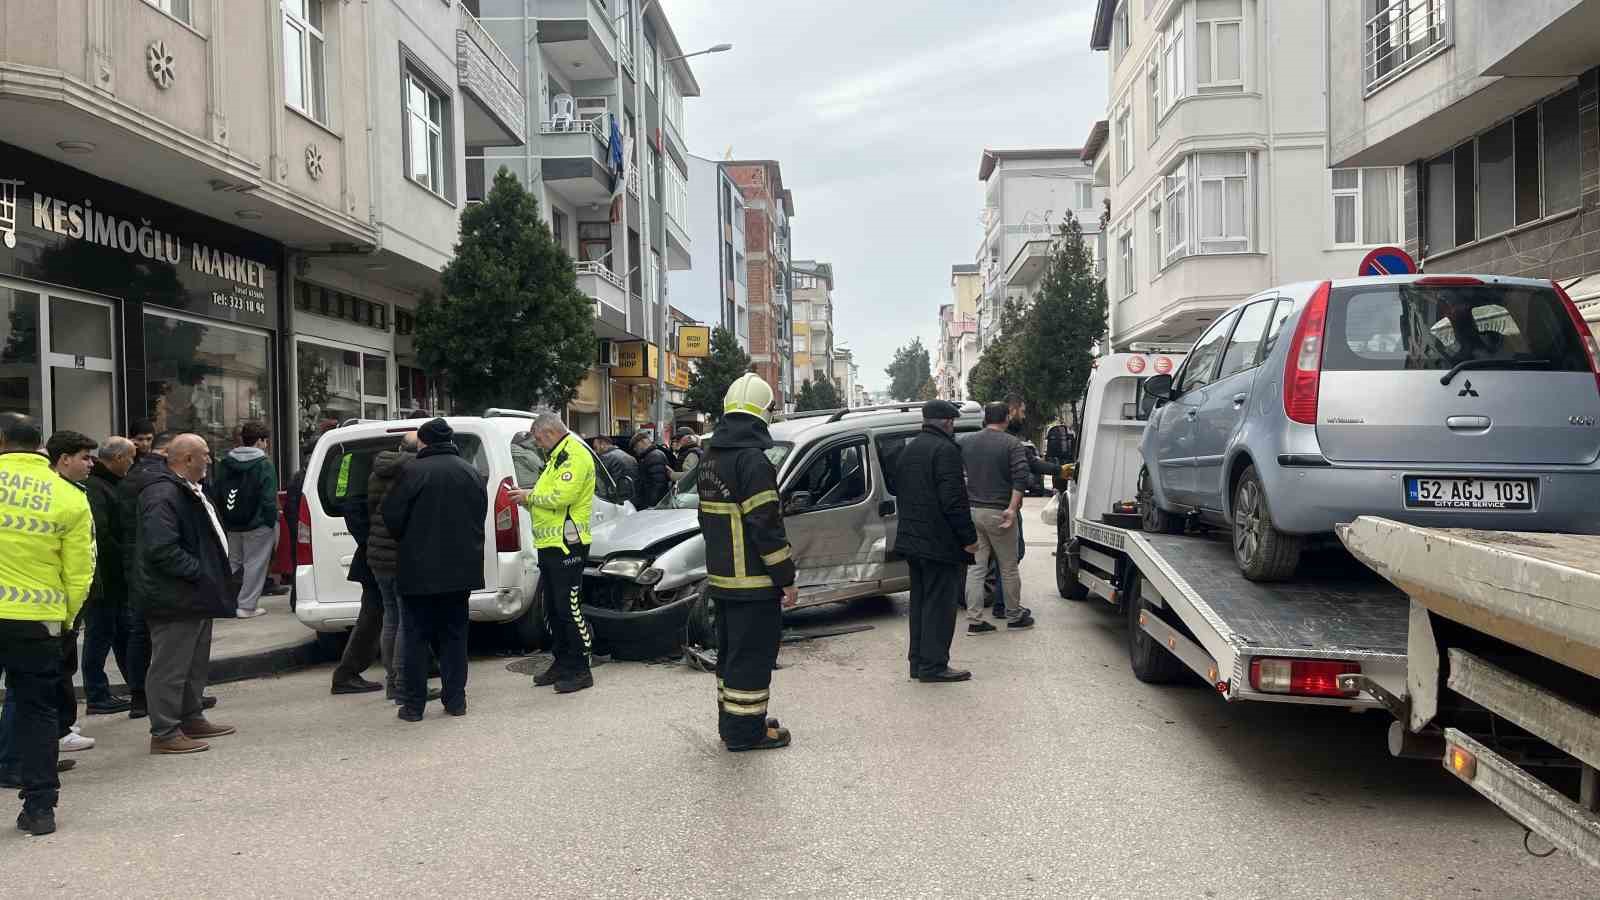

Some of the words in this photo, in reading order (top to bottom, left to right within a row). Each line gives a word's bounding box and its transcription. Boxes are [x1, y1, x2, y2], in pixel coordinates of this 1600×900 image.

[33, 191, 181, 265] KESİMOĞLU
[192, 242, 266, 289] MARKET
[212, 291, 228, 306] Tel:
[1420, 480, 1442, 500] 52
[1494, 482, 1525, 502] 103
